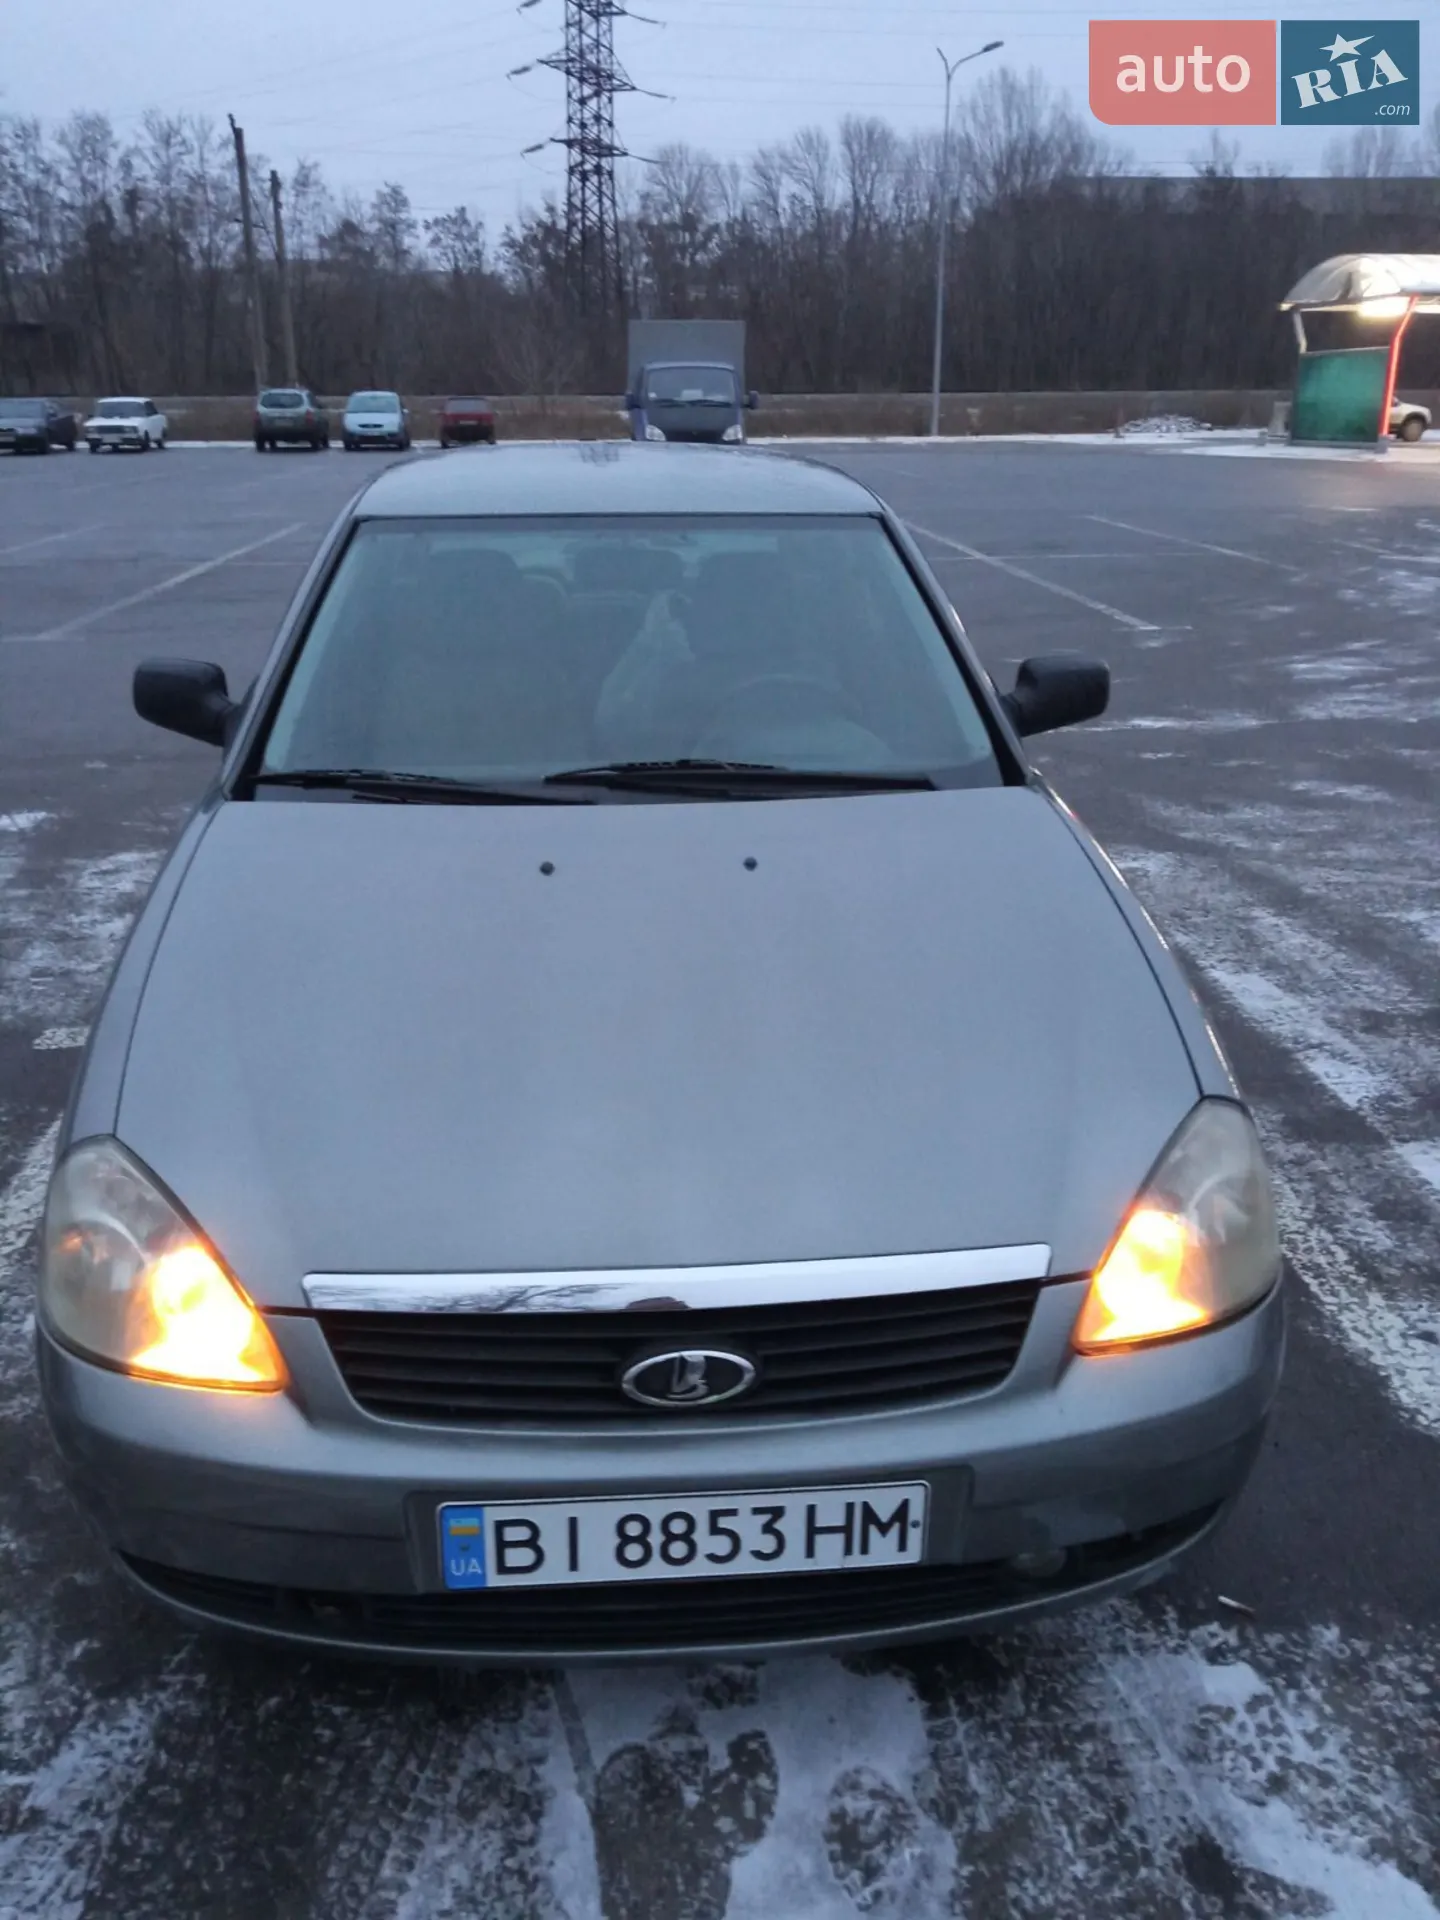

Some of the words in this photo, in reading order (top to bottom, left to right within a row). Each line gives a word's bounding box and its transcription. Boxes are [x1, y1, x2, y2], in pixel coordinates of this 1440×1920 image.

[494, 1516, 579, 1576] BI
[614, 1505, 787, 1569] 8853
[804, 1498, 911, 1559] HM
[450, 1557, 483, 1576] UA
